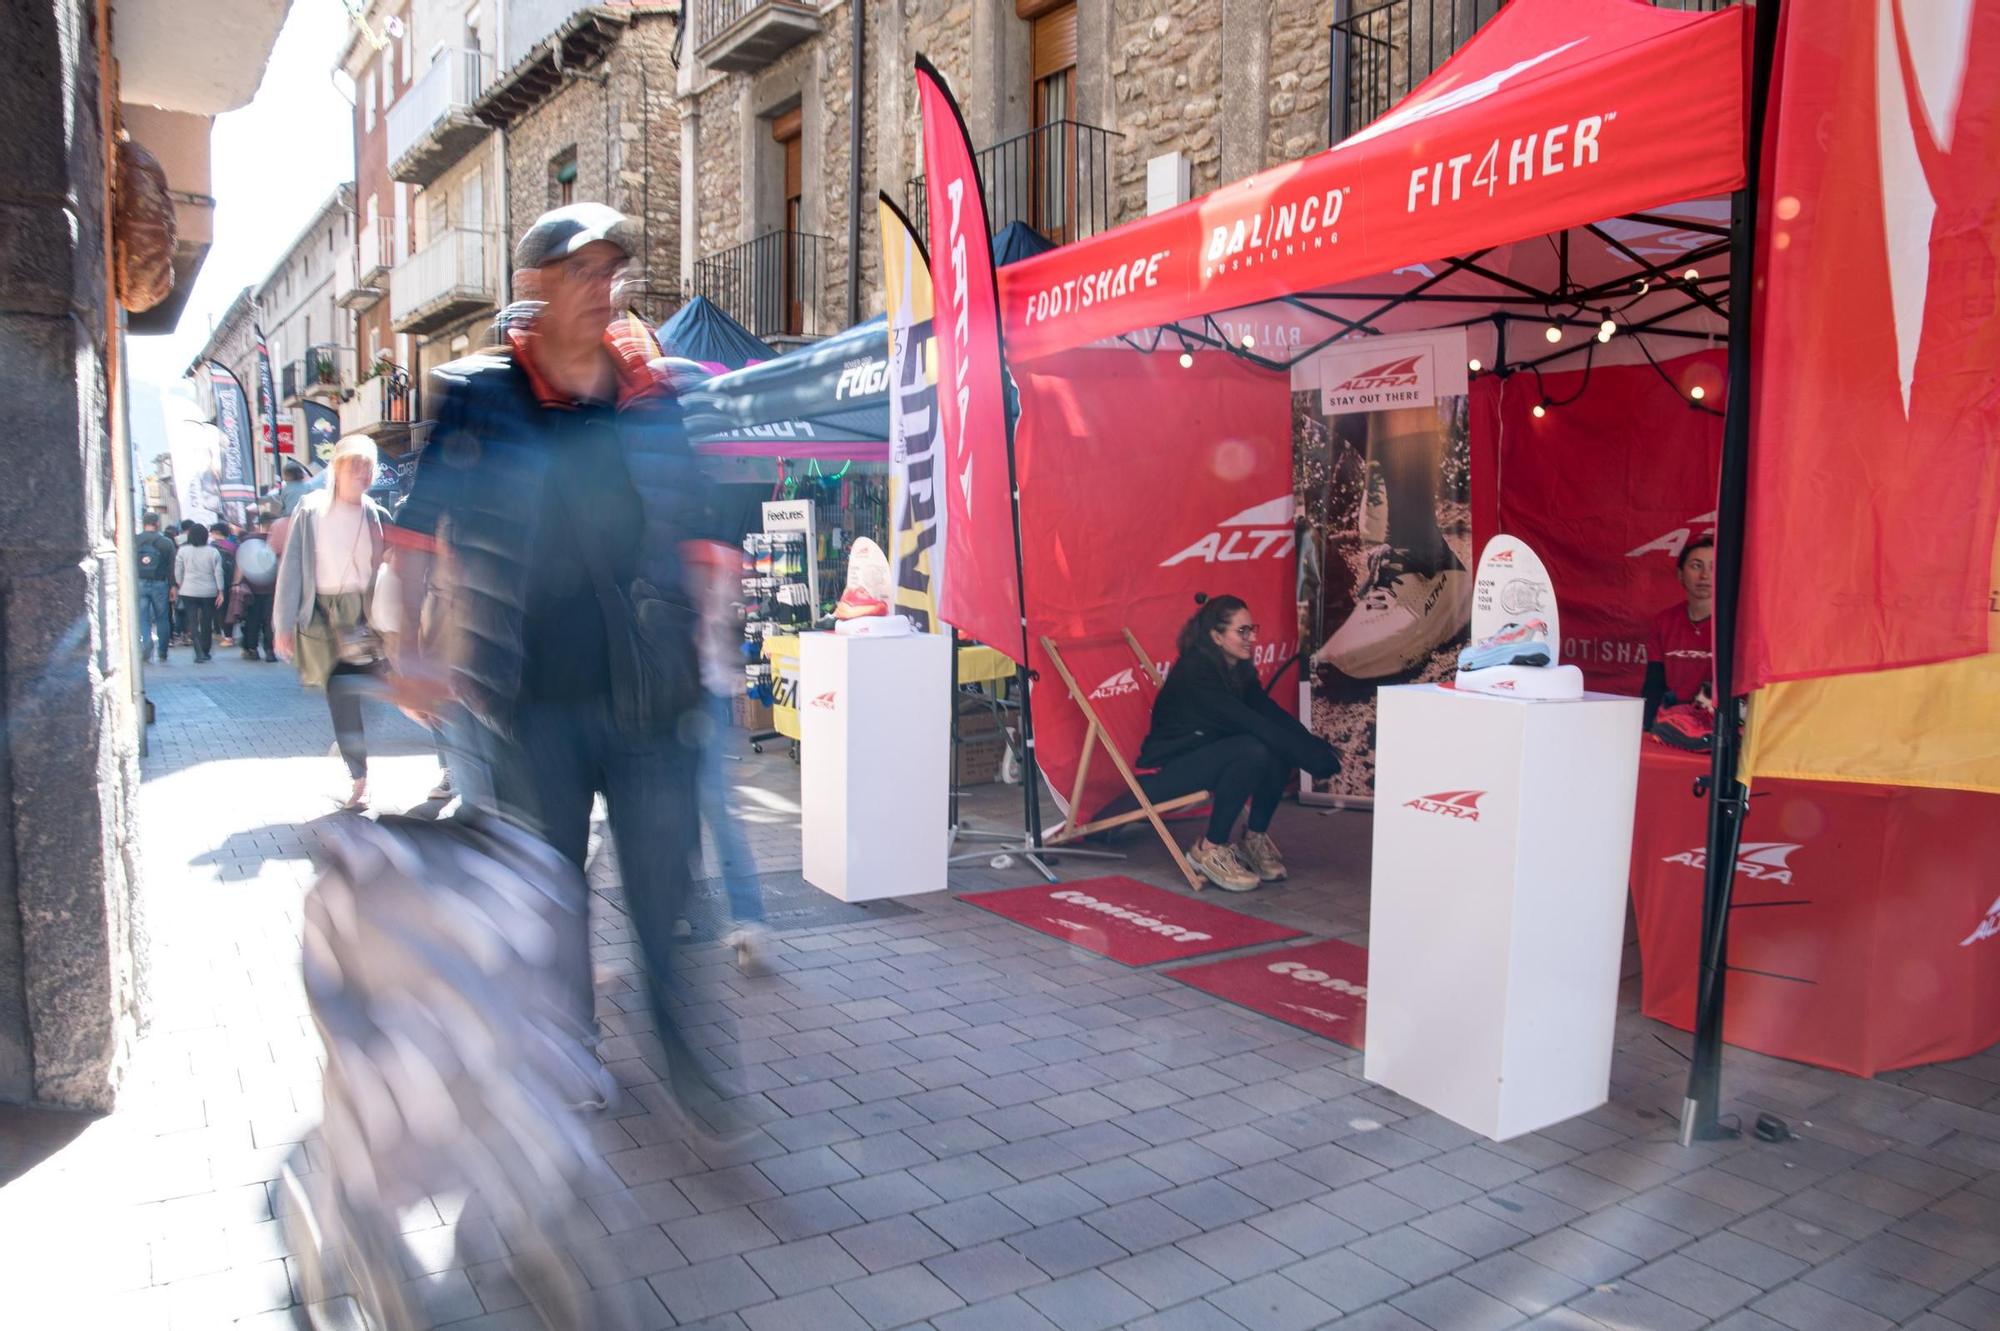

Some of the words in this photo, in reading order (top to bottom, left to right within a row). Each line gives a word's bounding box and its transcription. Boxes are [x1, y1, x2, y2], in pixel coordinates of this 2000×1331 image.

[1206, 232, 1338, 279] CUSHIONING
[1330, 375, 1418, 392] ALTRA
[1330, 395, 1355, 406] STAY
[1359, 394, 1381, 404] OUT
[1385, 391, 1419, 402] THERE
[1088, 681, 1140, 700] ALTRA
[1402, 799, 1480, 822] ALTRA
[1049, 890, 1213, 942] COMFORT
[1266, 961, 1368, 1001] COM
